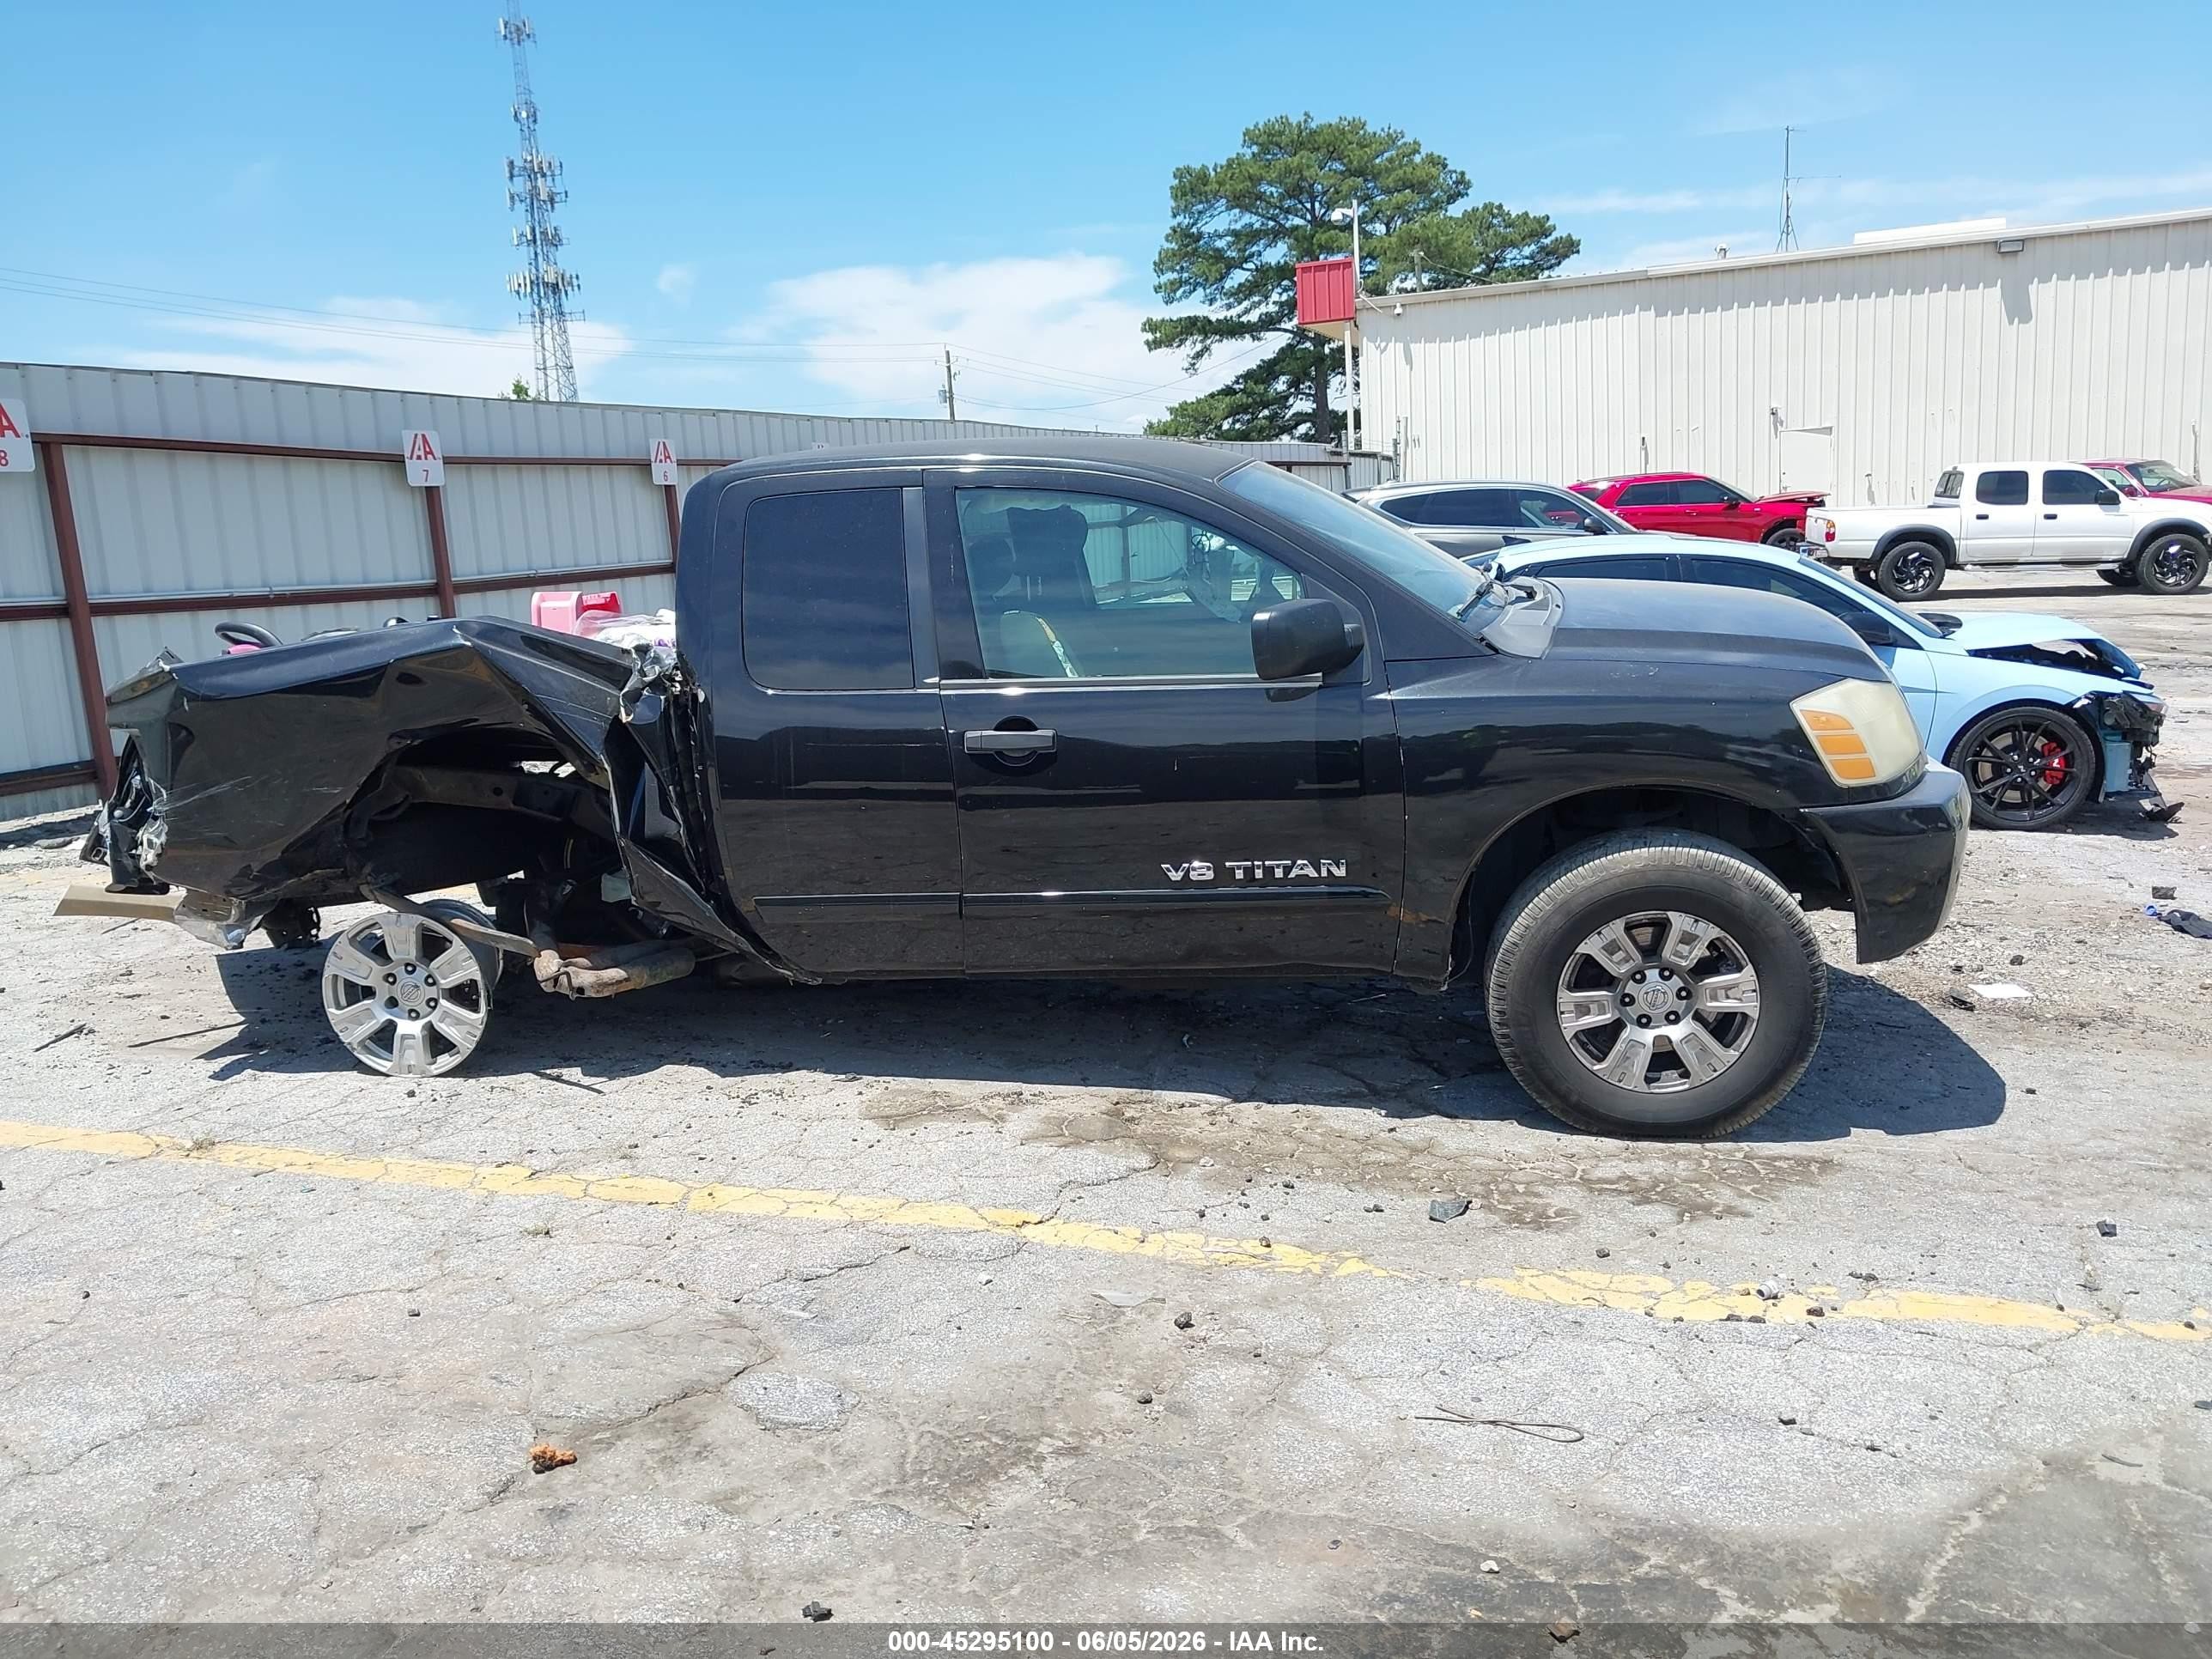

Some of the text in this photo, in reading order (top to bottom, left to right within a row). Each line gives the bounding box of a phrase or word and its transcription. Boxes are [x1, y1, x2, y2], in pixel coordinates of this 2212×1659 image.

[422, 469, 429, 483] 7
[663, 470, 668, 482] 6
[1160, 859, 1346, 882] V8 TITAN
